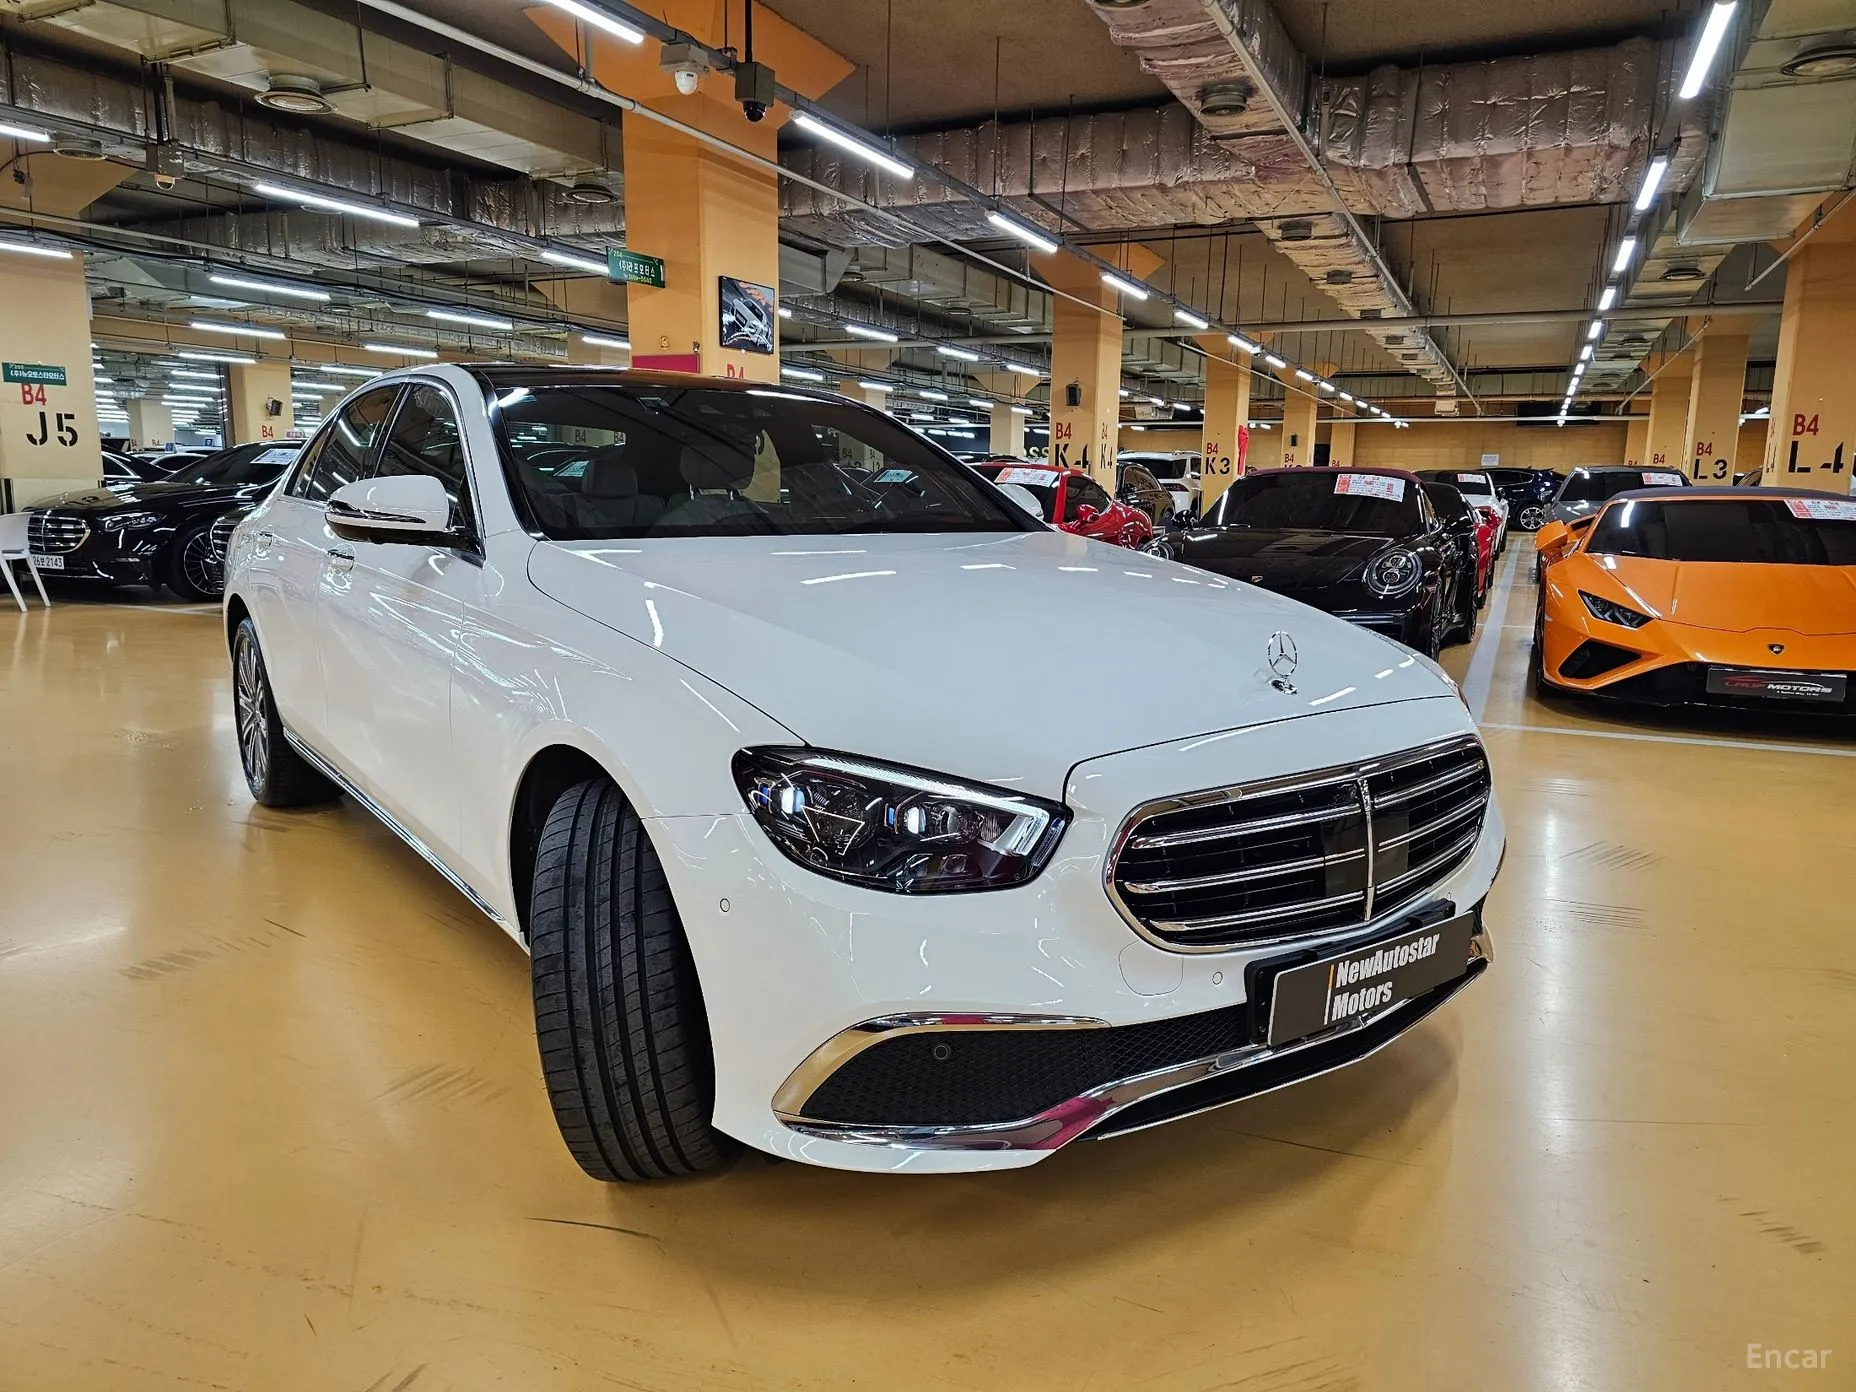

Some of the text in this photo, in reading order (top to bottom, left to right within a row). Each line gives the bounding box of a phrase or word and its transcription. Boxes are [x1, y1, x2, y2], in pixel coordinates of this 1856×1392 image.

[21, 383, 47, 406] B4
[1055, 422, 1072, 440] B4
[1101, 422, 1108, 440] B4
[1793, 413, 1820, 436] B4
[262, 425, 273, 438] B4
[575, 429, 586, 443] B4
[614, 432, 624, 443] B4
[842, 448, 852, 458] B4
[1206, 442, 1219, 455] B4
[1696, 442, 1713, 456] B4
[1284, 453, 1294, 463] B4
[1653, 454, 1665, 464] B4
[46, 557, 63, 567] 2143
[1767, 683, 1833, 693] MOTORS
[1336, 933, 1440, 988] NewAutostar
[1332, 981, 1393, 1022] Motors
